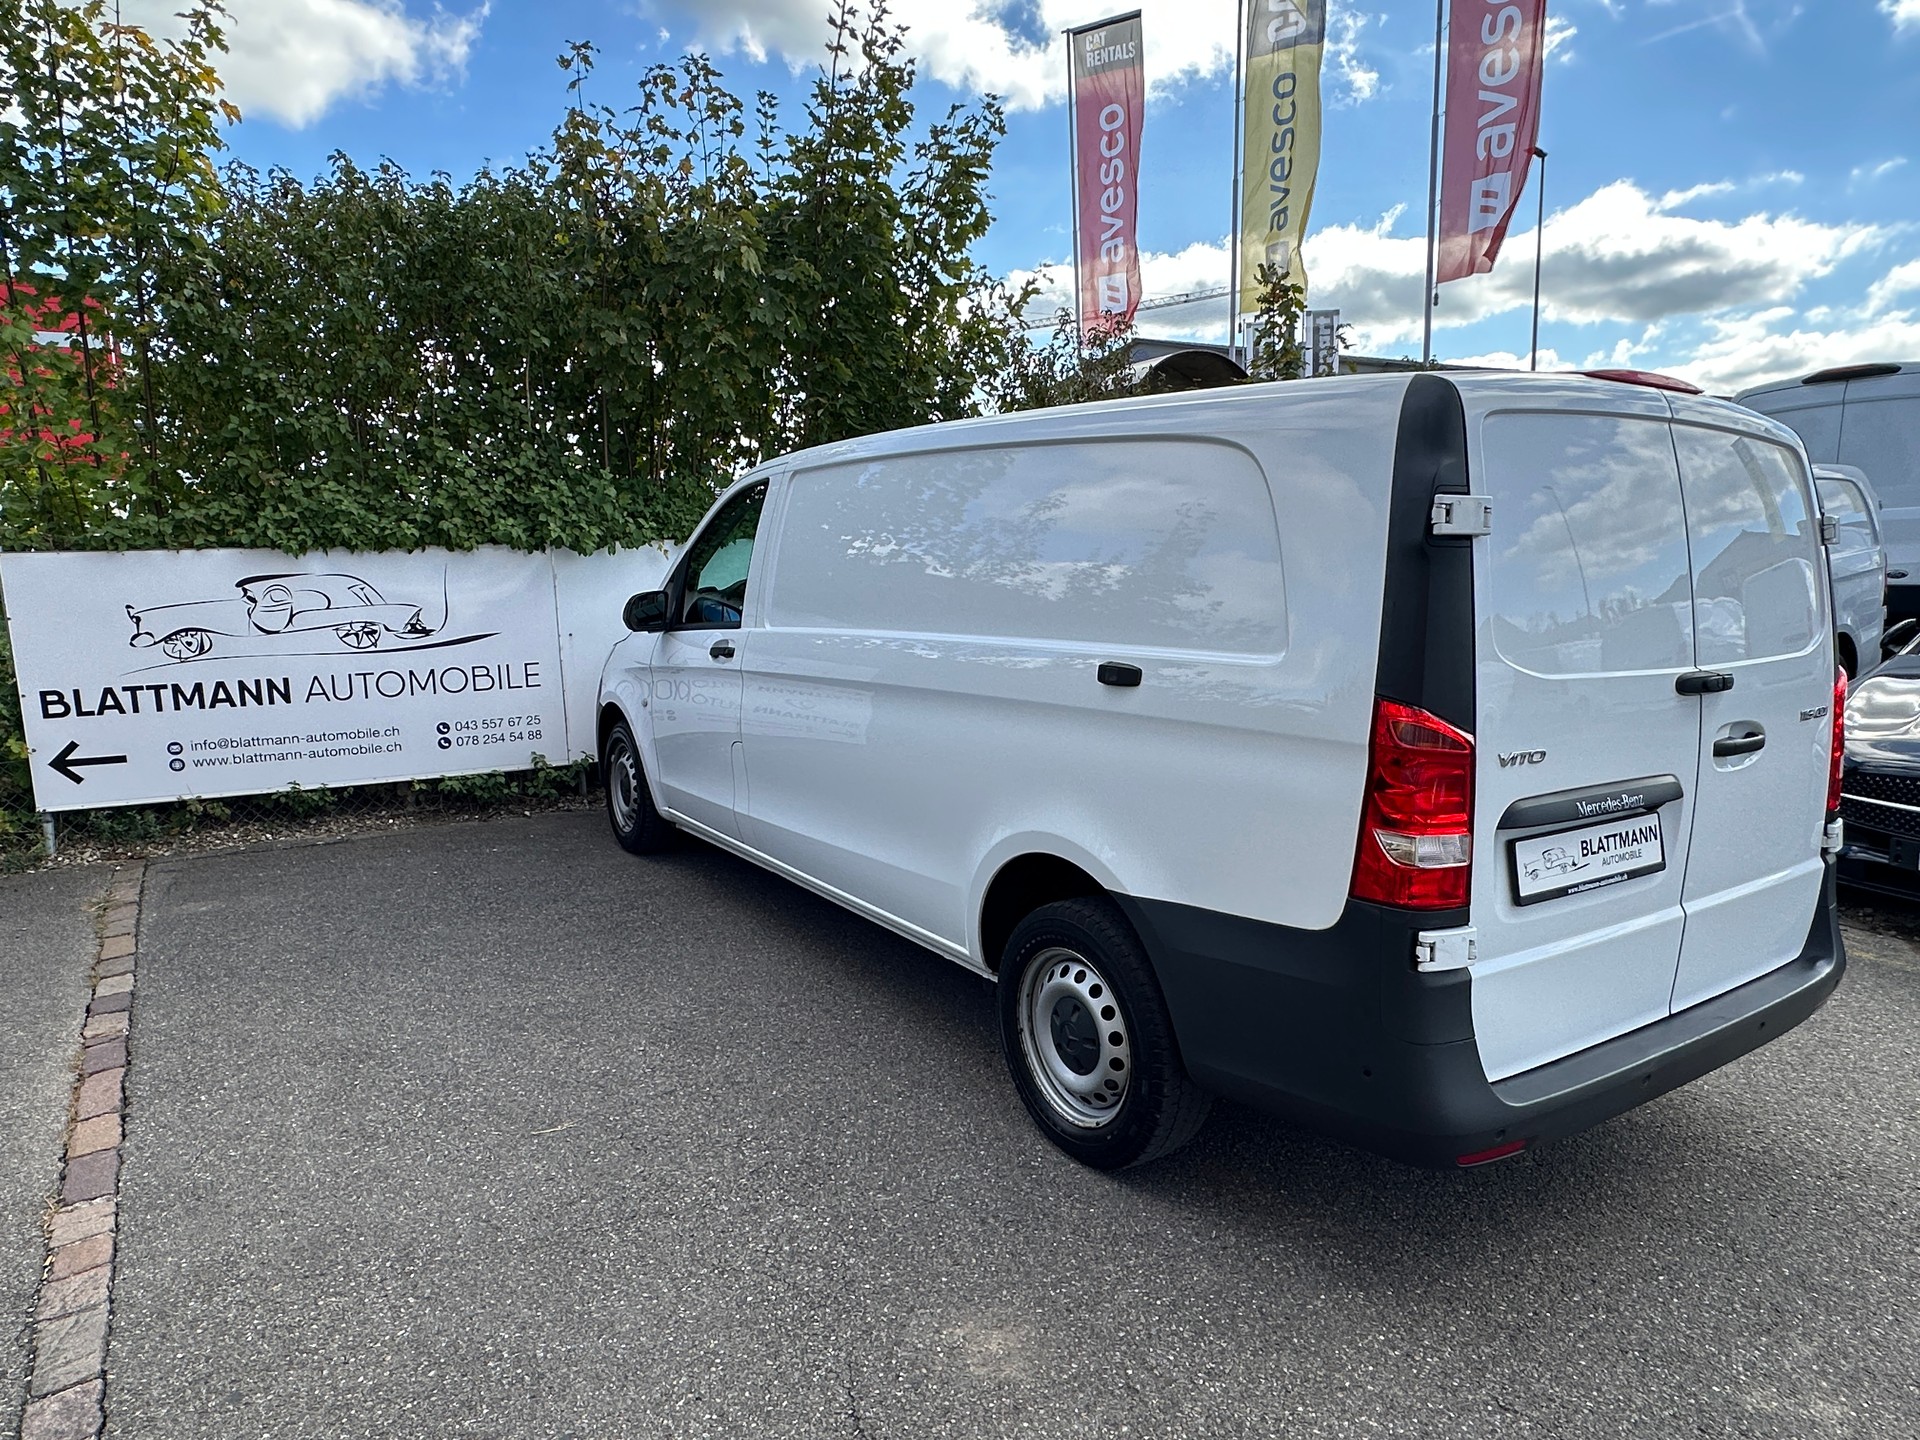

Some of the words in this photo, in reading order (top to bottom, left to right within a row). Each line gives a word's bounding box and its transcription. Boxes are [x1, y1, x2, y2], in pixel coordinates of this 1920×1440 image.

[1086, 31, 1106, 51] CAT
[1086, 41, 1136, 67] RENTALS
[1476, 0, 1522, 161] aves
[1269, 72, 1297, 233] avesco
[1099, 103, 1125, 264] avesco
[39, 677, 292, 719] BLATTMANN
[305, 662, 541, 703] AUTOMOBILE
[455, 720, 478, 732] 043
[481, 718, 503, 729] 557
[508, 716, 522, 727] 67
[526, 715, 541, 726] 25
[190, 726, 400, 752] info@blattmann-automobile.ch
[456, 735, 479, 747] 078
[482, 733, 505, 745] 254
[509, 731, 524, 742] 54
[527, 729, 542, 740] 88
[192, 742, 402, 768] www.blattmann-automobile.ch
[1498, 750, 1546, 768] VITO
[1576, 794, 1645, 817] Mercedes-Benz
[1580, 824, 1658, 858] BLATTMANN
[1602, 848, 1642, 867] AUTOMOBILE
